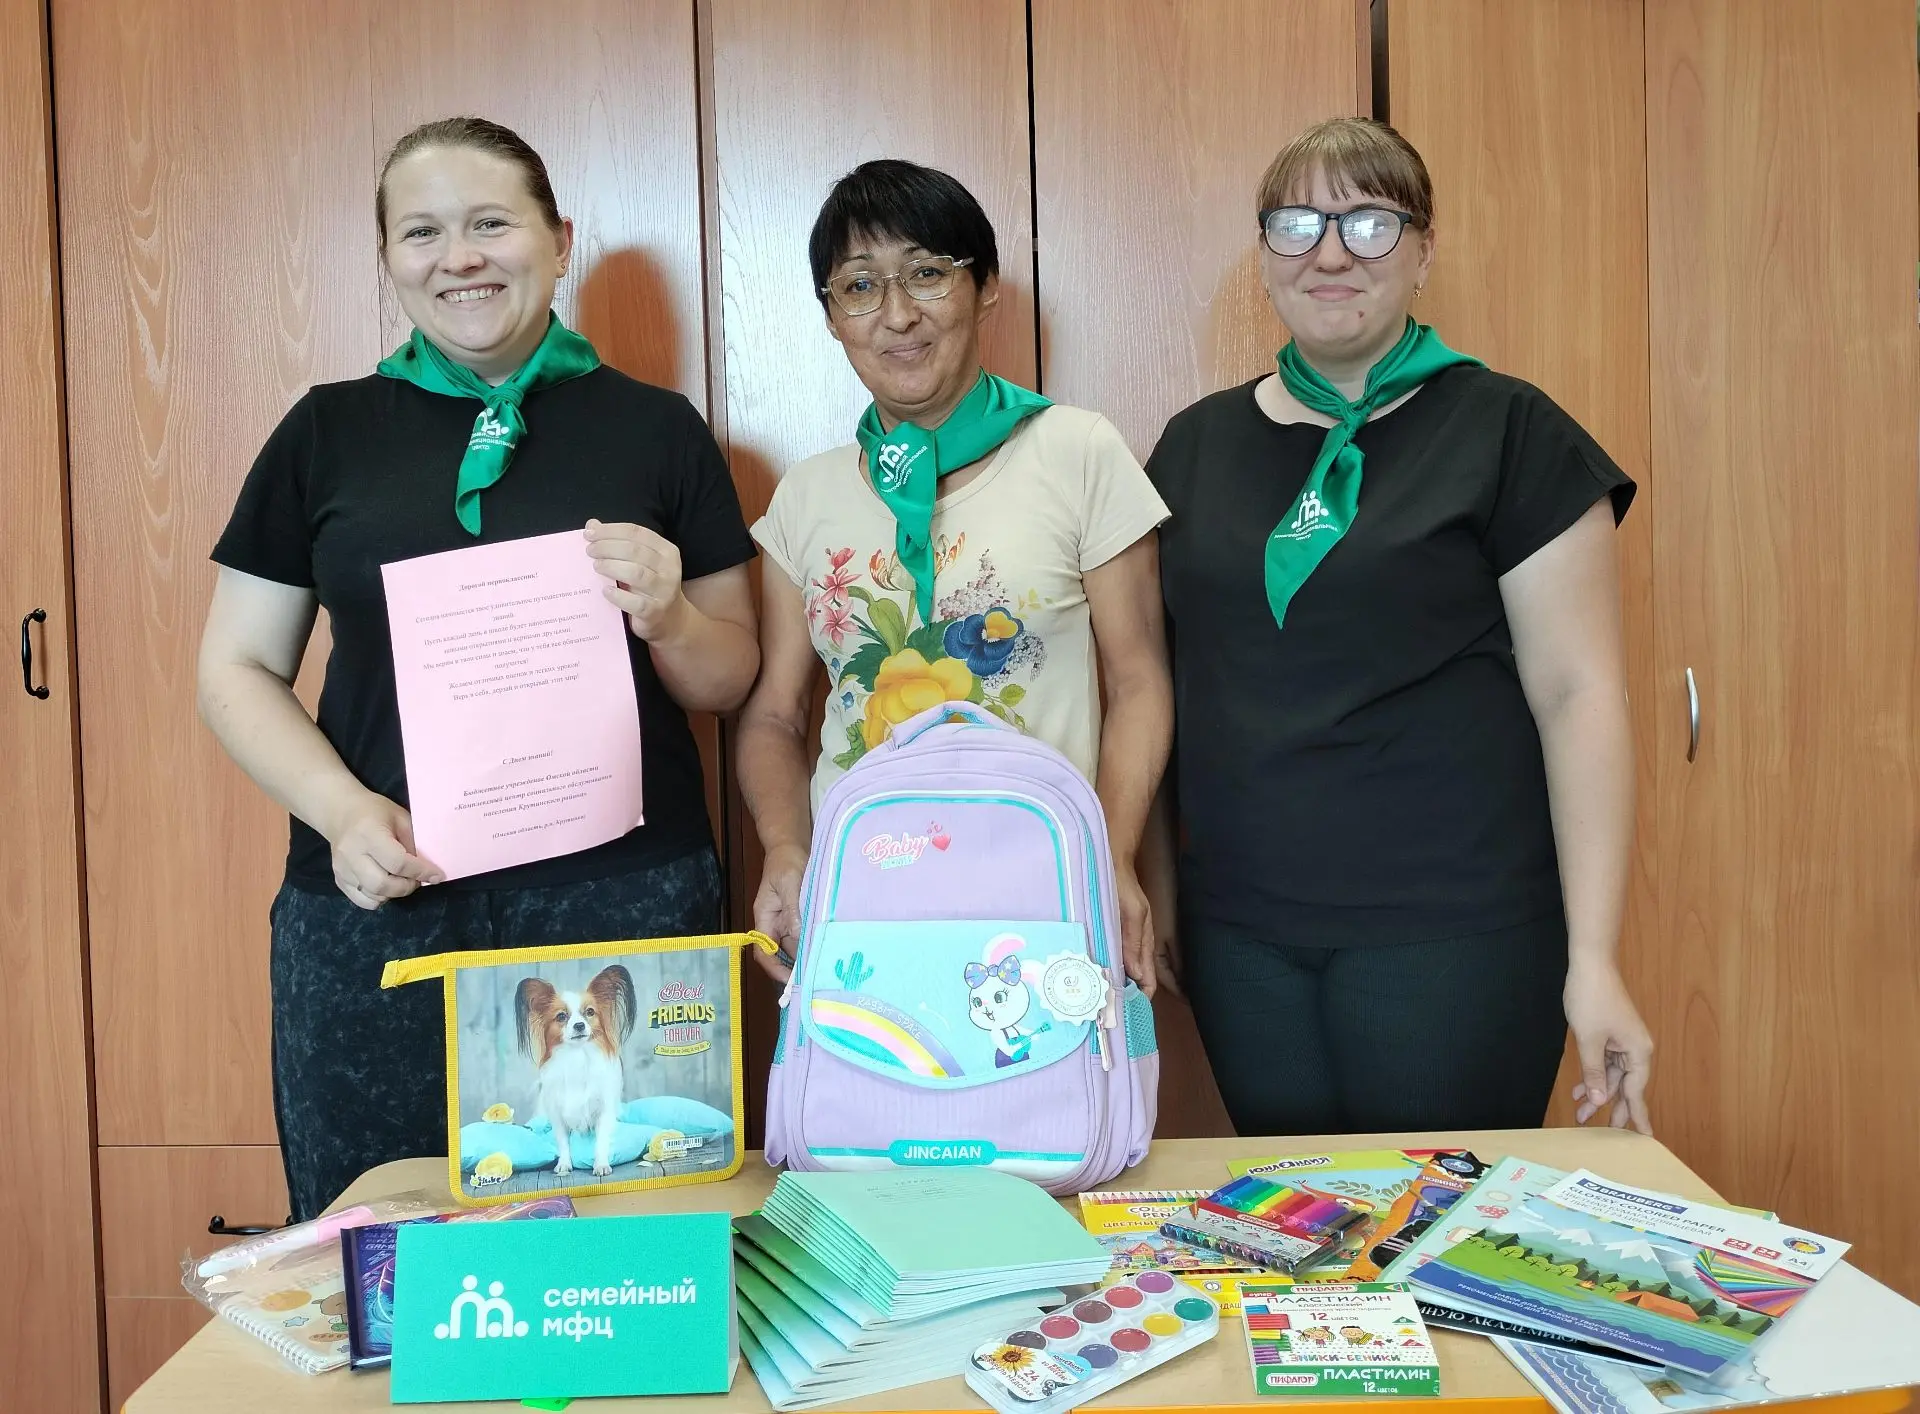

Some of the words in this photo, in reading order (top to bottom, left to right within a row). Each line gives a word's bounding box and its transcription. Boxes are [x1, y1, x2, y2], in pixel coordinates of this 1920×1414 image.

[458, 580, 486, 592] Дорогой
[528, 749, 553, 761] знаний!
[463, 784, 505, 797] Бюджетное
[505, 776, 545, 790] учреждение
[546, 772, 571, 781] Омской
[571, 765, 599, 776] области
[483, 807, 517, 817] населения
[862, 831, 930, 864] Baby
[659, 981, 705, 1002] Best
[856, 995, 894, 1017] RABBIT
[648, 1001, 716, 1028] FRIENDS
[664, 1026, 702, 1043] FOREVER
[896, 1014, 924, 1041] SPACE
[904, 1145, 981, 1160] JINCAIAN
[1249, 1157, 1331, 1174] ЮНЛАНДИЯ
[1599, 1187, 1673, 1211] BRAUBERG
[1569, 1186, 1619, 1204] GLOSSY
[1619, 1203, 1680, 1221] COLORED
[1682, 1219, 1727, 1233] PAPER
[1788, 1257, 1807, 1266] A4
[543, 1277, 697, 1307] семейный
[1266, 1295, 1392, 1304] ПЛАСТИЛИН
[1310, 1312, 1328, 1321] 12
[542, 1310, 614, 1342] мфц
[1290, 1353, 1401, 1363] ЭНИКИ-БЕНИКИ
[1023, 1370, 1040, 1382] 24
[1270, 1376, 1315, 1384] ПИФАГОР
[1323, 1368, 1431, 1381] ПЛАСТИЛИН
[1362, 1382, 1376, 1393] 12
[1377, 1386, 1398, 1394] цветов
